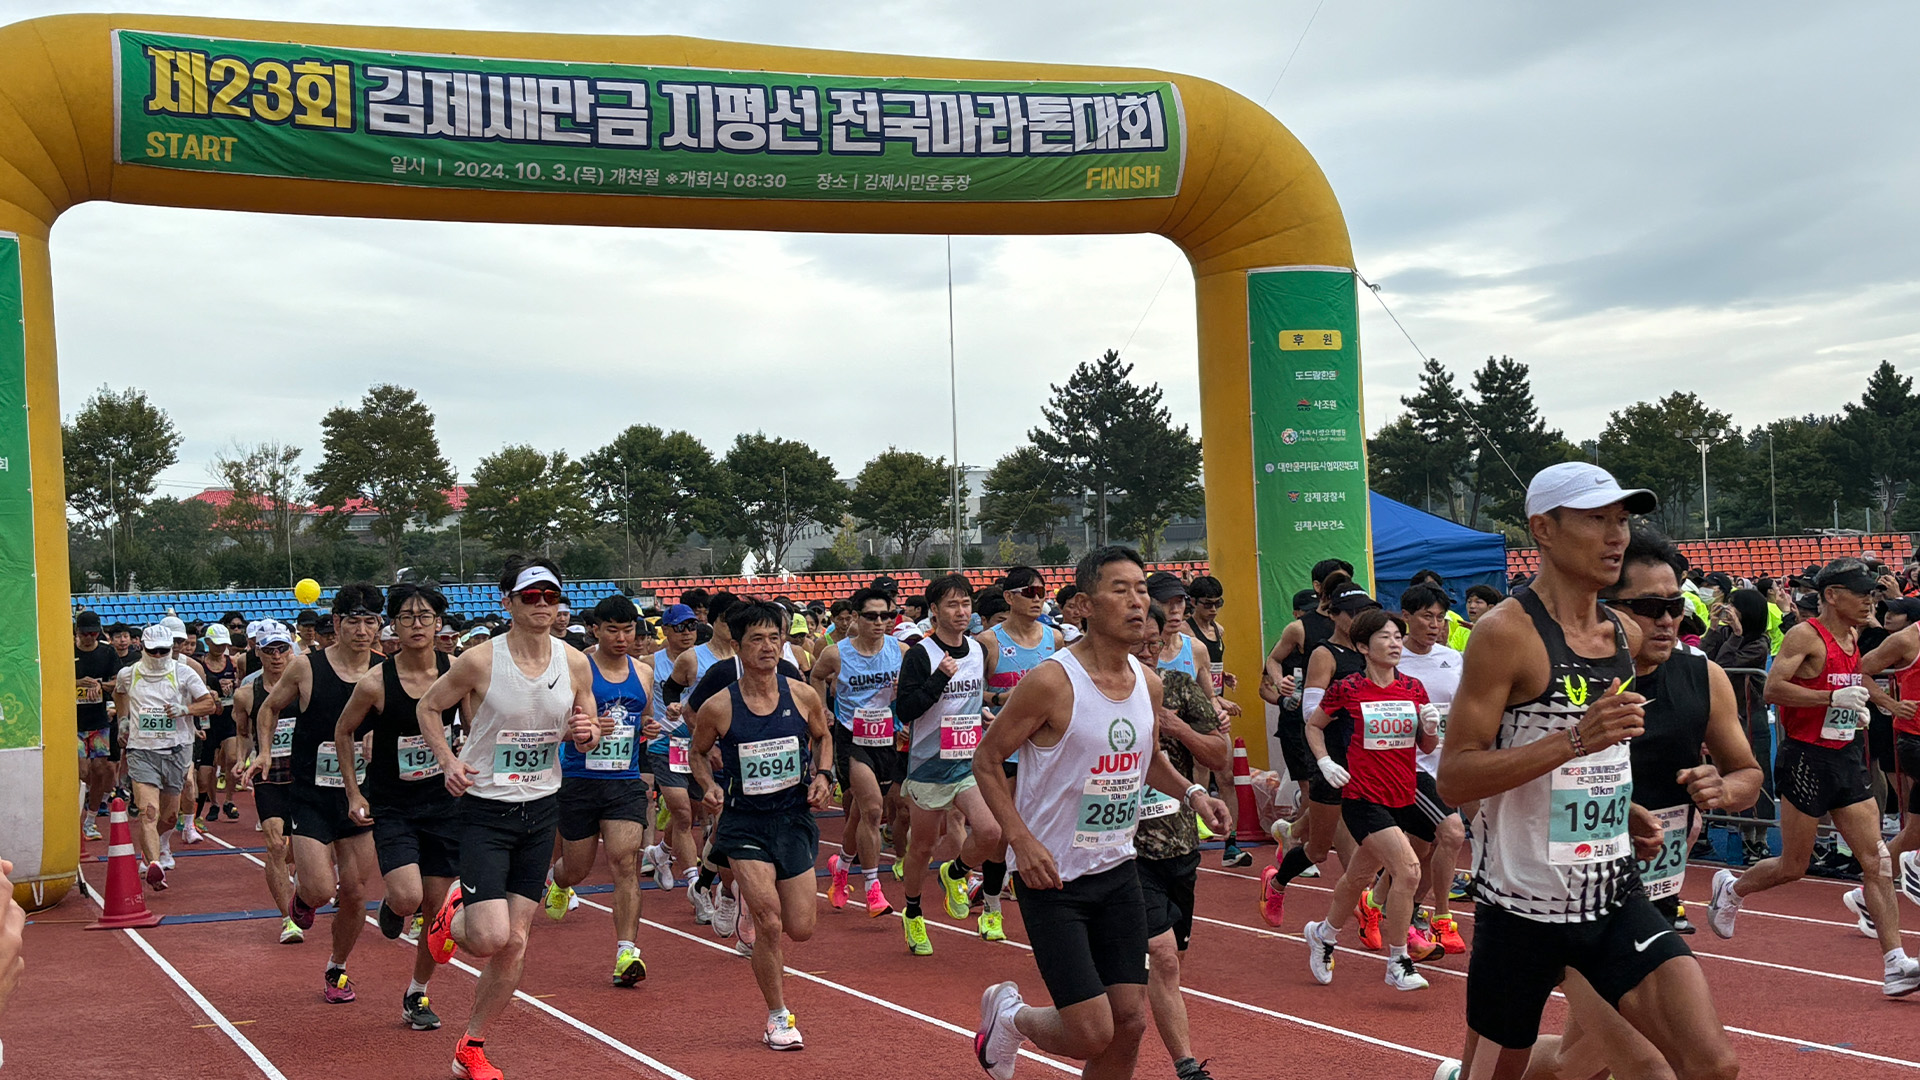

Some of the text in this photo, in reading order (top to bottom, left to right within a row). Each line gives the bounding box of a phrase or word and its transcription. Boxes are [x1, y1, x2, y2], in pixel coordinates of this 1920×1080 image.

[146, 46, 1166, 154] 제23회 김제새만금 지평선 전국마라톤대회
[145, 131, 239, 163] START
[390, 156, 426, 176] 일시
[454, 161, 509, 180] 2024.
[515, 162, 546, 181] 10.
[609, 167, 660, 187] 개천절
[733, 173, 787, 189] 08:30
[1084, 165, 1162, 191] FINISH
[816, 172, 848, 191] 장소
[863, 174, 972, 192] 김제시민운동장
[1292, 333, 1334, 346] 후 원
[1303, 491, 1347, 503] 김제경찰서
[1293, 520, 1347, 532] 김제시보건소
[848, 670, 899, 687] GUNSAN
[943, 678, 983, 694] GUNSAN
[142, 718, 173, 729] 2618
[862, 722, 887, 735] 107
[1369, 718, 1413, 735] 3008
[951, 730, 977, 746] 108
[1113, 729, 1131, 739] RUN
[591, 741, 630, 756] 2514
[502, 748, 549, 768] 1931
[1090, 751, 1143, 775] JUDY
[746, 756, 796, 779] 2694
[1590, 785, 1615, 796] 10km
[1085, 799, 1136, 826] 2856
[1564, 795, 1627, 833] 1943
